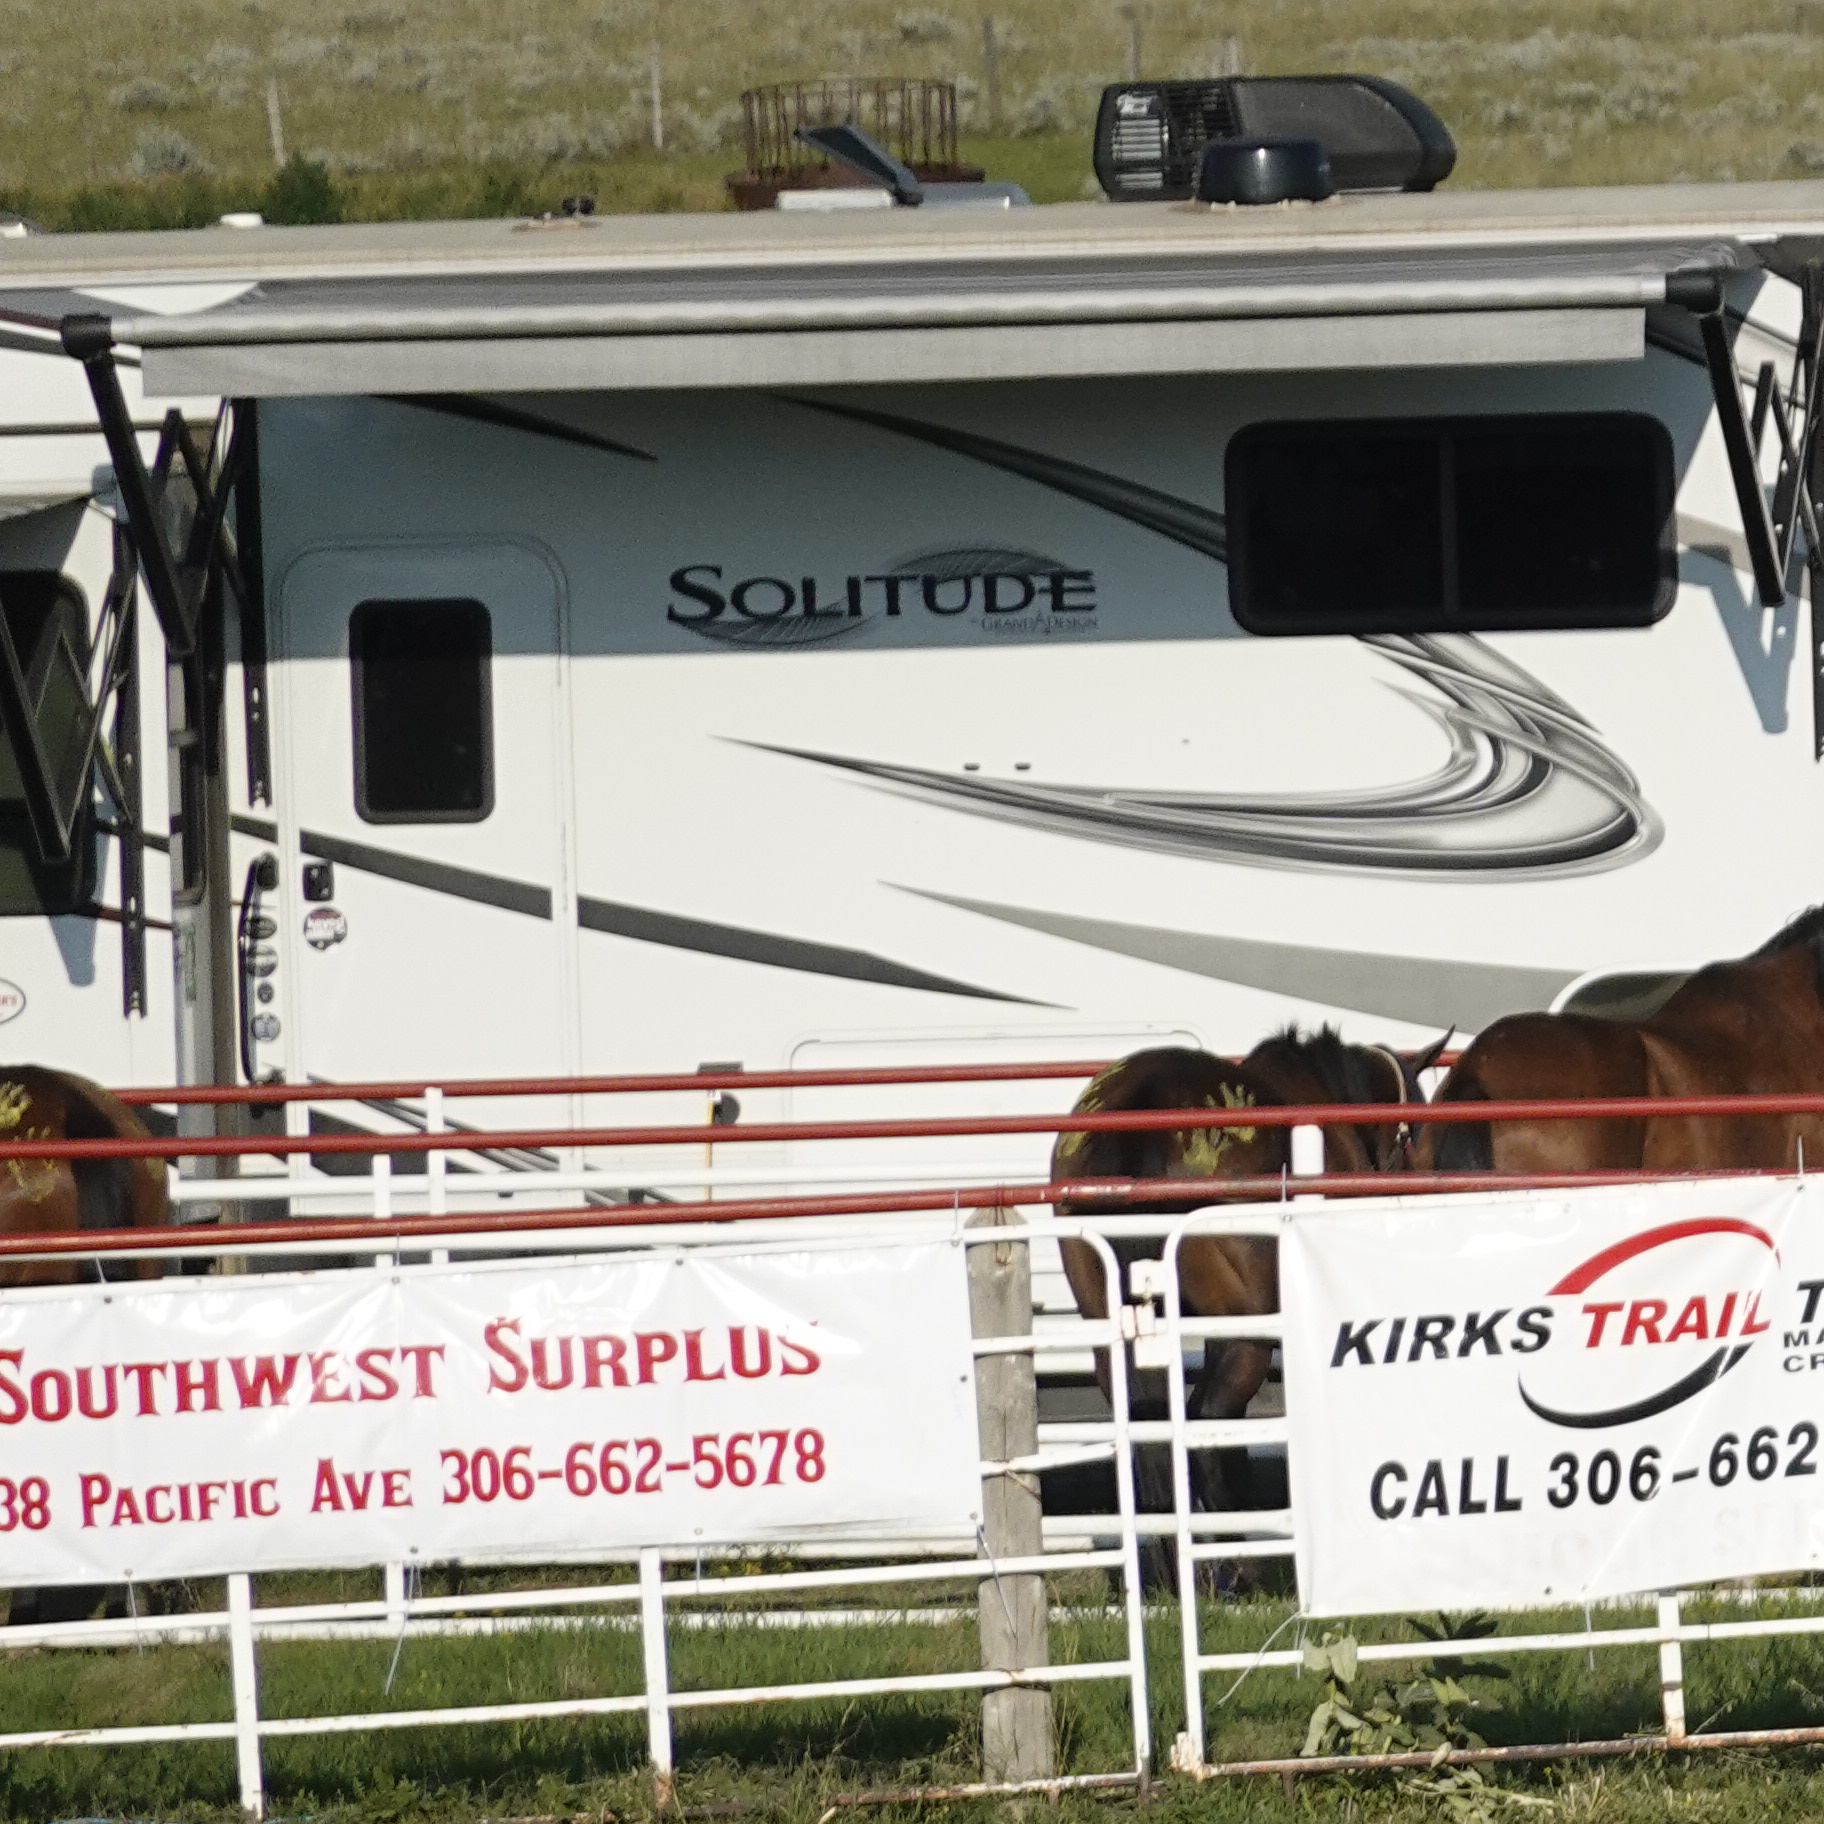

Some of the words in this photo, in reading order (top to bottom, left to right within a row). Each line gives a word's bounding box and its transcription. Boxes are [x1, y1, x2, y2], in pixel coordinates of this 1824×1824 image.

[667, 563, 1098, 622] SOLITUDE
[1329, 1304, 1556, 1369] KIRKS
[1580, 1289, 1772, 1349] TRAIL
[0, 1342, 446, 1426] SOUTHWEST
[483, 1315, 823, 1395] SURPLUS
[78, 1471, 282, 1529] PACIFIC
[310, 1456, 415, 1514] AVE
[438, 1427, 827, 1505] 306-662-5678
[1369, 1452, 1524, 1522] CALL
